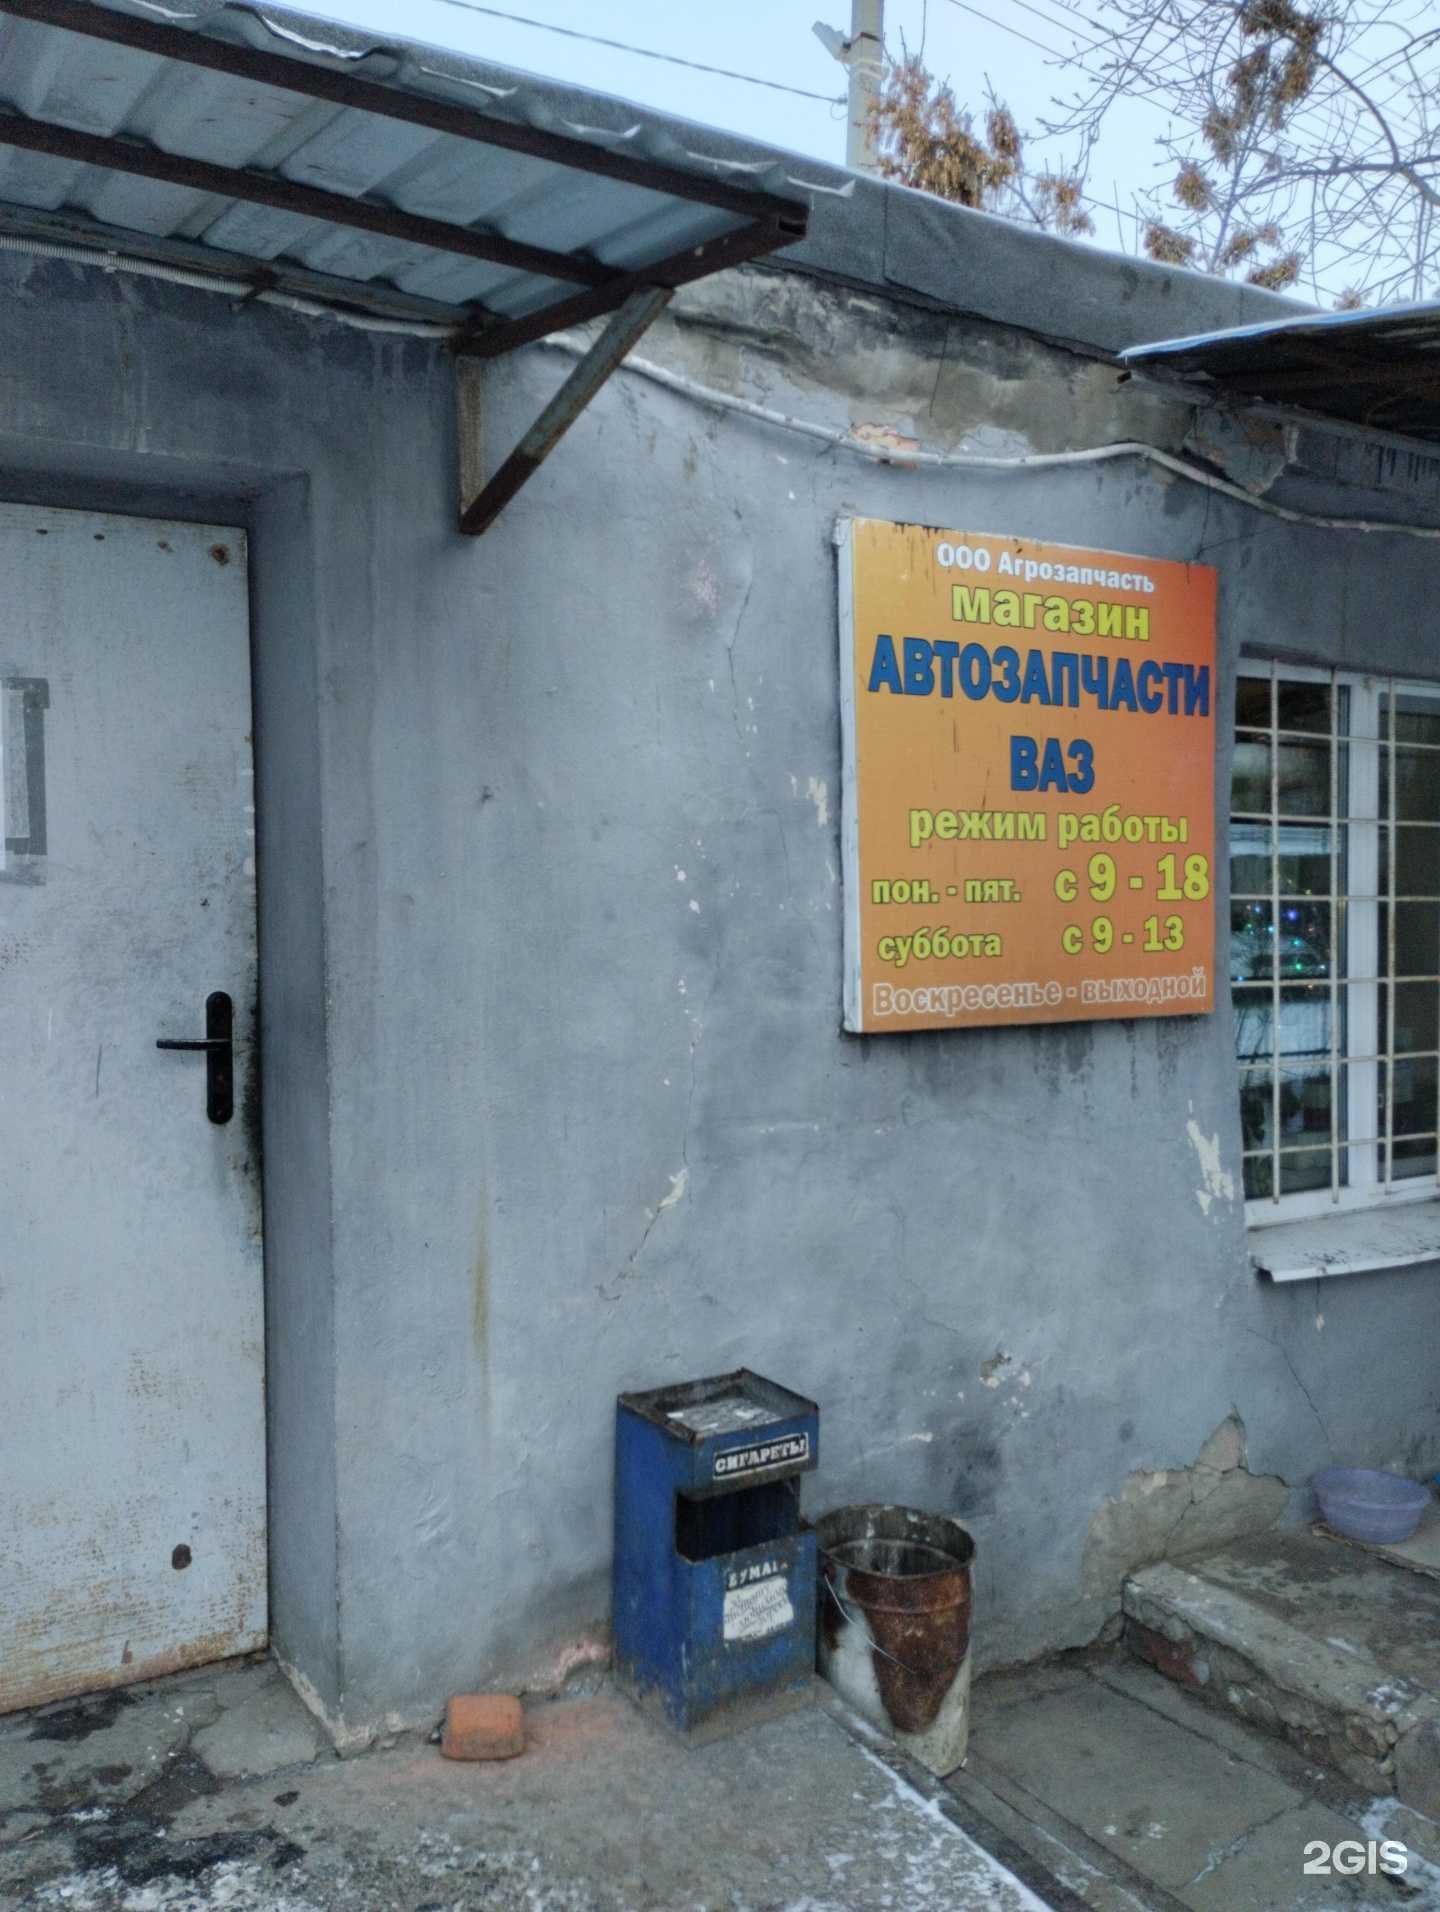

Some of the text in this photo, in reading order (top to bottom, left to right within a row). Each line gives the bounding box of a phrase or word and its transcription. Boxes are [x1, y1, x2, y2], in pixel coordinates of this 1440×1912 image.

[936, 542, 1155, 593] ООО Агрозапчасть
[951, 583, 1150, 641] магазин
[868, 634, 1210, 716] АВТОЗАПЧАСТИ
[1010, 735, 1095, 794] ВАЗ
[909, 803, 1189, 849] режим работы
[872, 879, 939, 903] пон.
[965, 879, 1021, 902] пят.
[1055, 868, 1077, 901] с
[1087, 852, 1117, 901] 9
[1128, 875, 1144, 890] -
[1156, 853, 1210, 901] 18
[877, 926, 1001, 967] суббота
[1061, 925, 1083, 955] с
[1091, 916, 1113, 953] 9
[1143, 914, 1185, 952] 13
[873, 982, 1062, 1016] Воскресенье
[1081, 966, 1206, 1004] выходной
[714, 1437, 806, 1473] СИГАРЕТЫ
